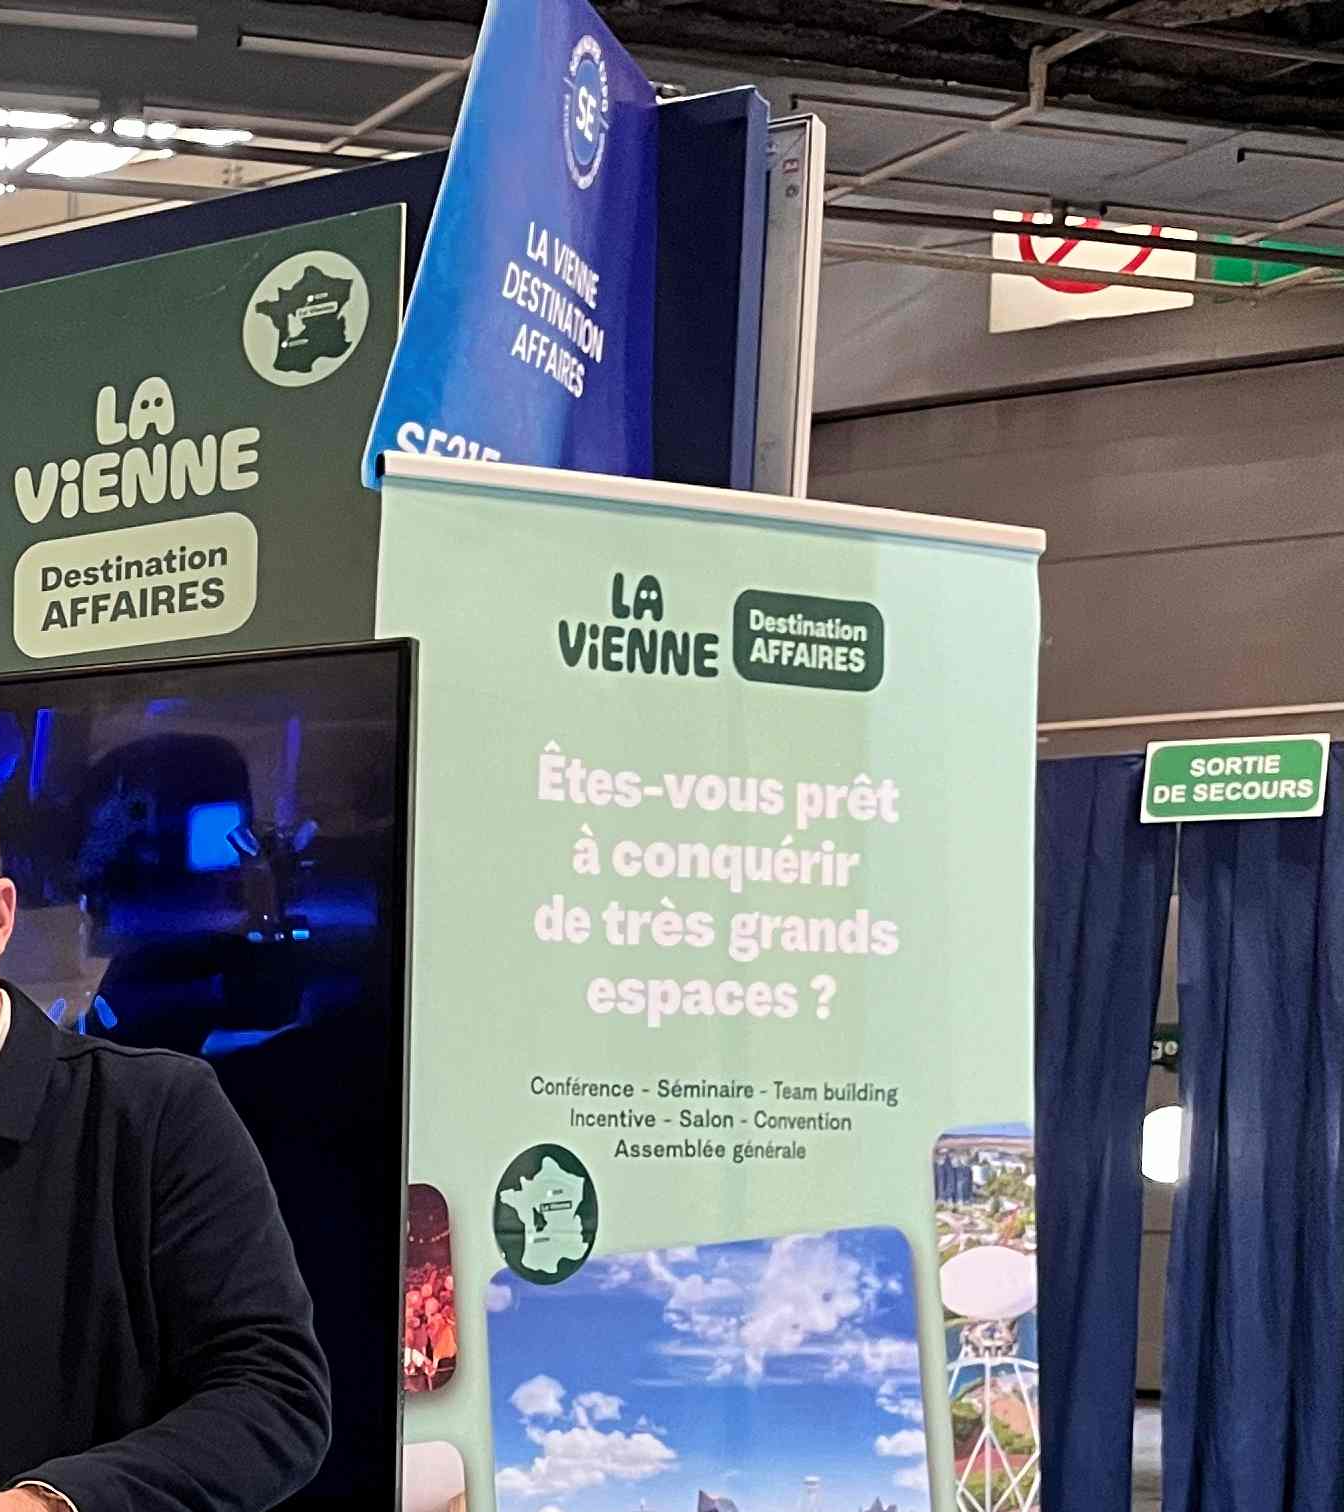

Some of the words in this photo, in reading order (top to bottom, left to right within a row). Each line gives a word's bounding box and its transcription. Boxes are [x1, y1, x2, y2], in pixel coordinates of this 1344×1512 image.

[526, 221, 548, 267] LA
[554, 237, 600, 310] VIENNE
[502, 261, 605, 363] DESTINATION
[511, 323, 585, 398] AFFAIRES
[96, 376, 175, 445] LA
[41, 545, 228, 592] Destination
[41, 576, 226, 633] AFFAIRES
[612, 572, 664, 621] LA
[749, 607, 868, 643] Destination
[749, 637, 865, 673] AFFAIRES
[537, 739, 784, 816] Êtes-vous
[796, 773, 900, 830] prêt
[1190, 754, 1281, 777] SORTIE
[1153, 785, 1186, 804] DE
[1193, 779, 1313, 802] SECOURS
[572, 823, 600, 876] à
[612, 834, 860, 893] conquérir
[534, 894, 591, 944] de
[602, 897, 715, 948] très
[729, 909, 900, 961] grands
[587, 975, 799, 1028] espaces
[811, 974, 837, 1020] ?
[530, 1076, 634, 1100] Conférence
[657, 1078, 754, 1100] Séminaire
[773, 1081, 818, 1102] Team
[824, 1082, 899, 1107] building
[570, 1108, 657, 1130] Incentive
[679, 1109, 734, 1130] Salon
[754, 1110, 852, 1132] Convention
[614, 1138, 726, 1160] Assemblée
[733, 1140, 806, 1163] générale
